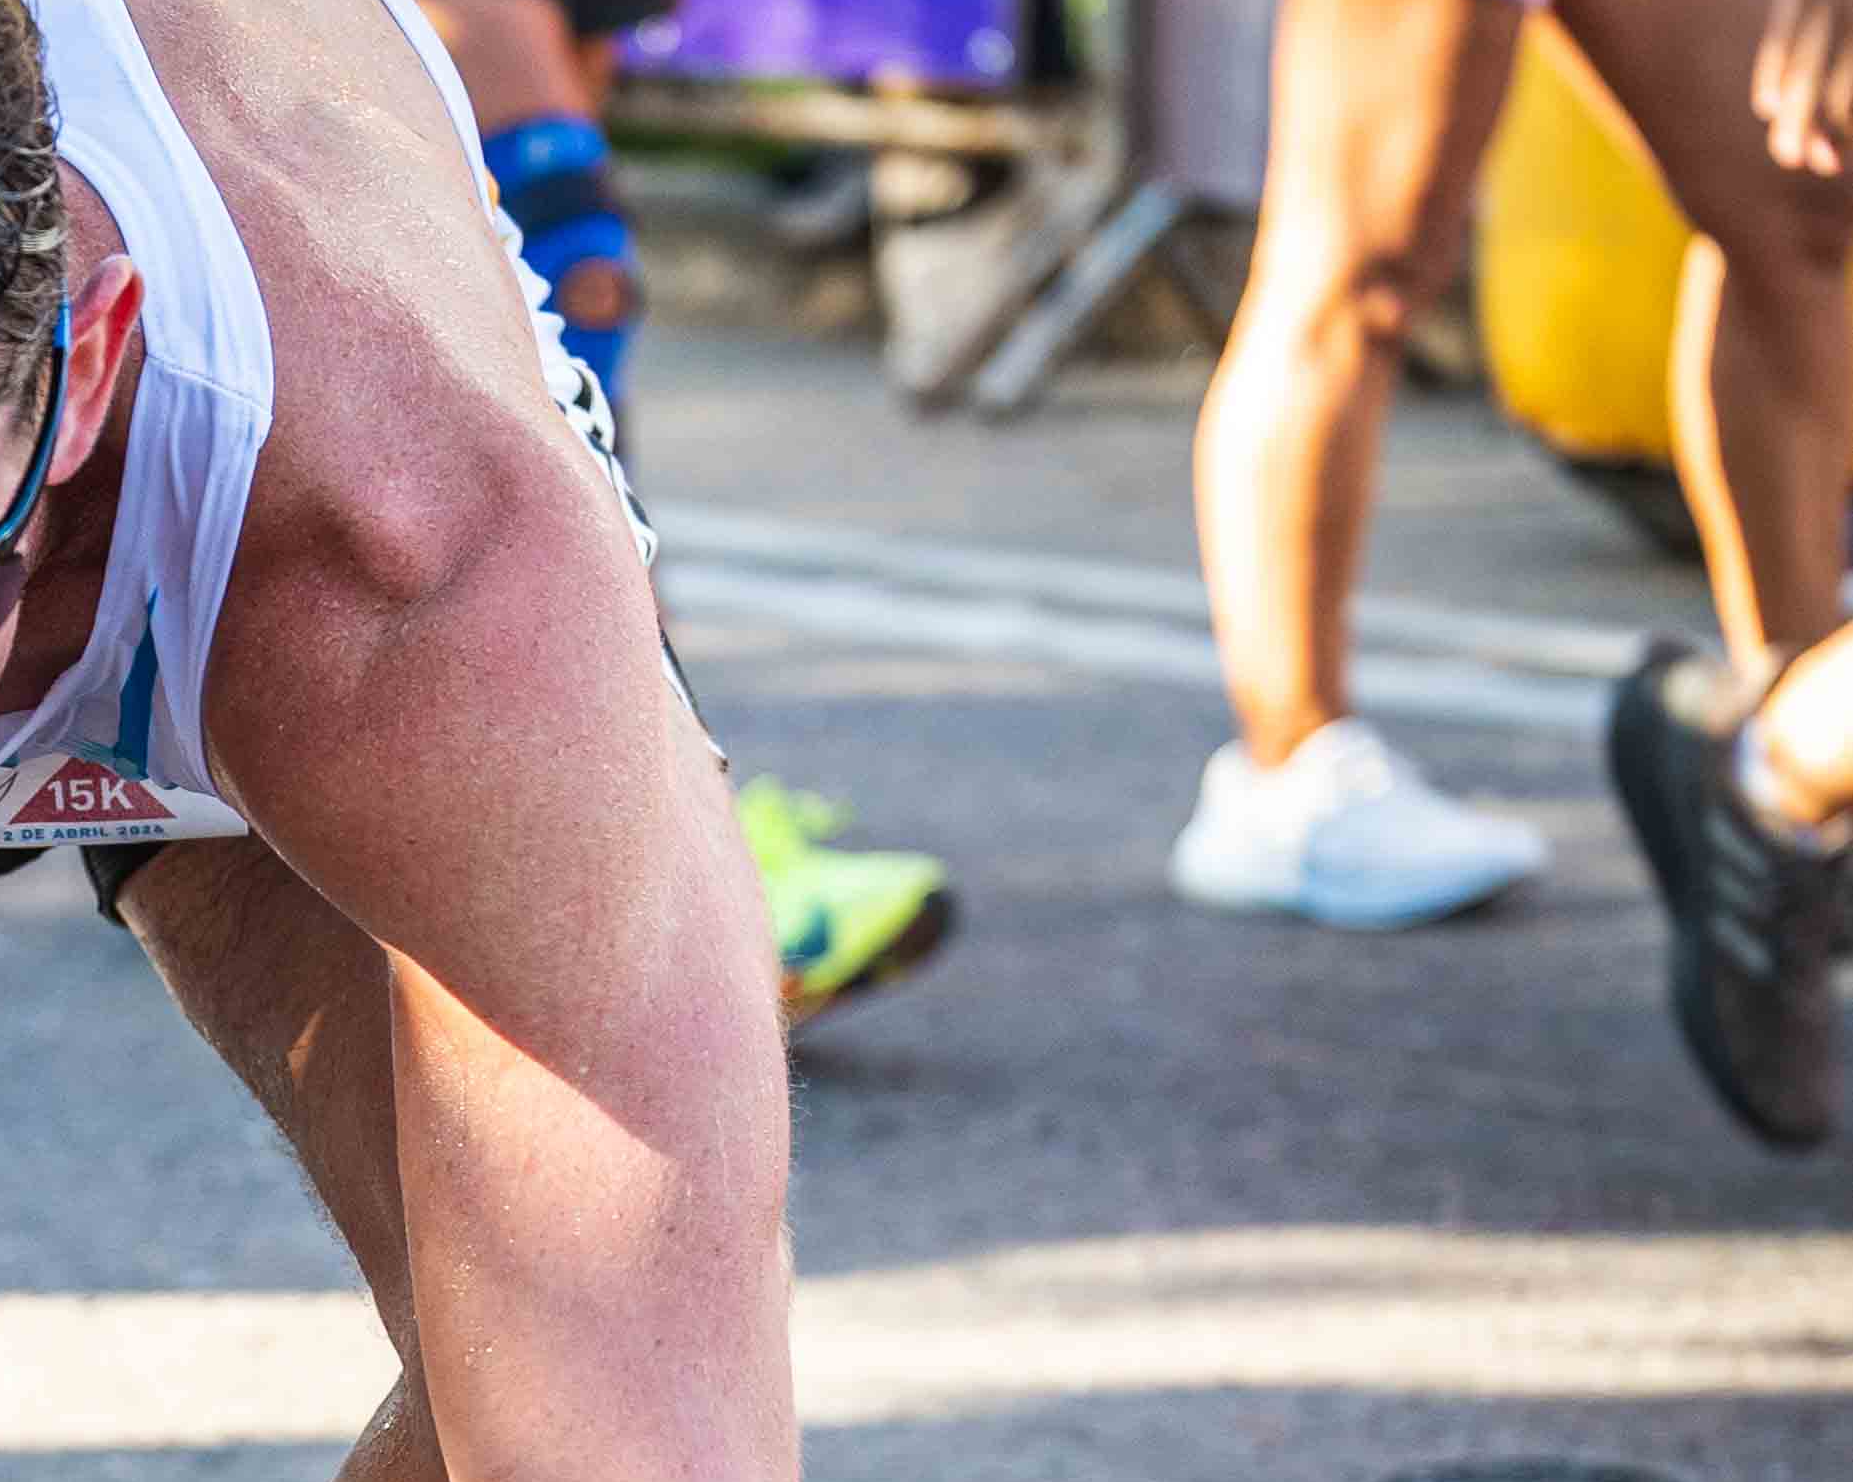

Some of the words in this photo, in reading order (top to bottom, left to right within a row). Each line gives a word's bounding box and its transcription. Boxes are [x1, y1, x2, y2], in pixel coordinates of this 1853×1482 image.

[48, 777, 133, 813] 15K
[20, 828, 45, 840] DE
[53, 826, 109, 839] ABRIL
